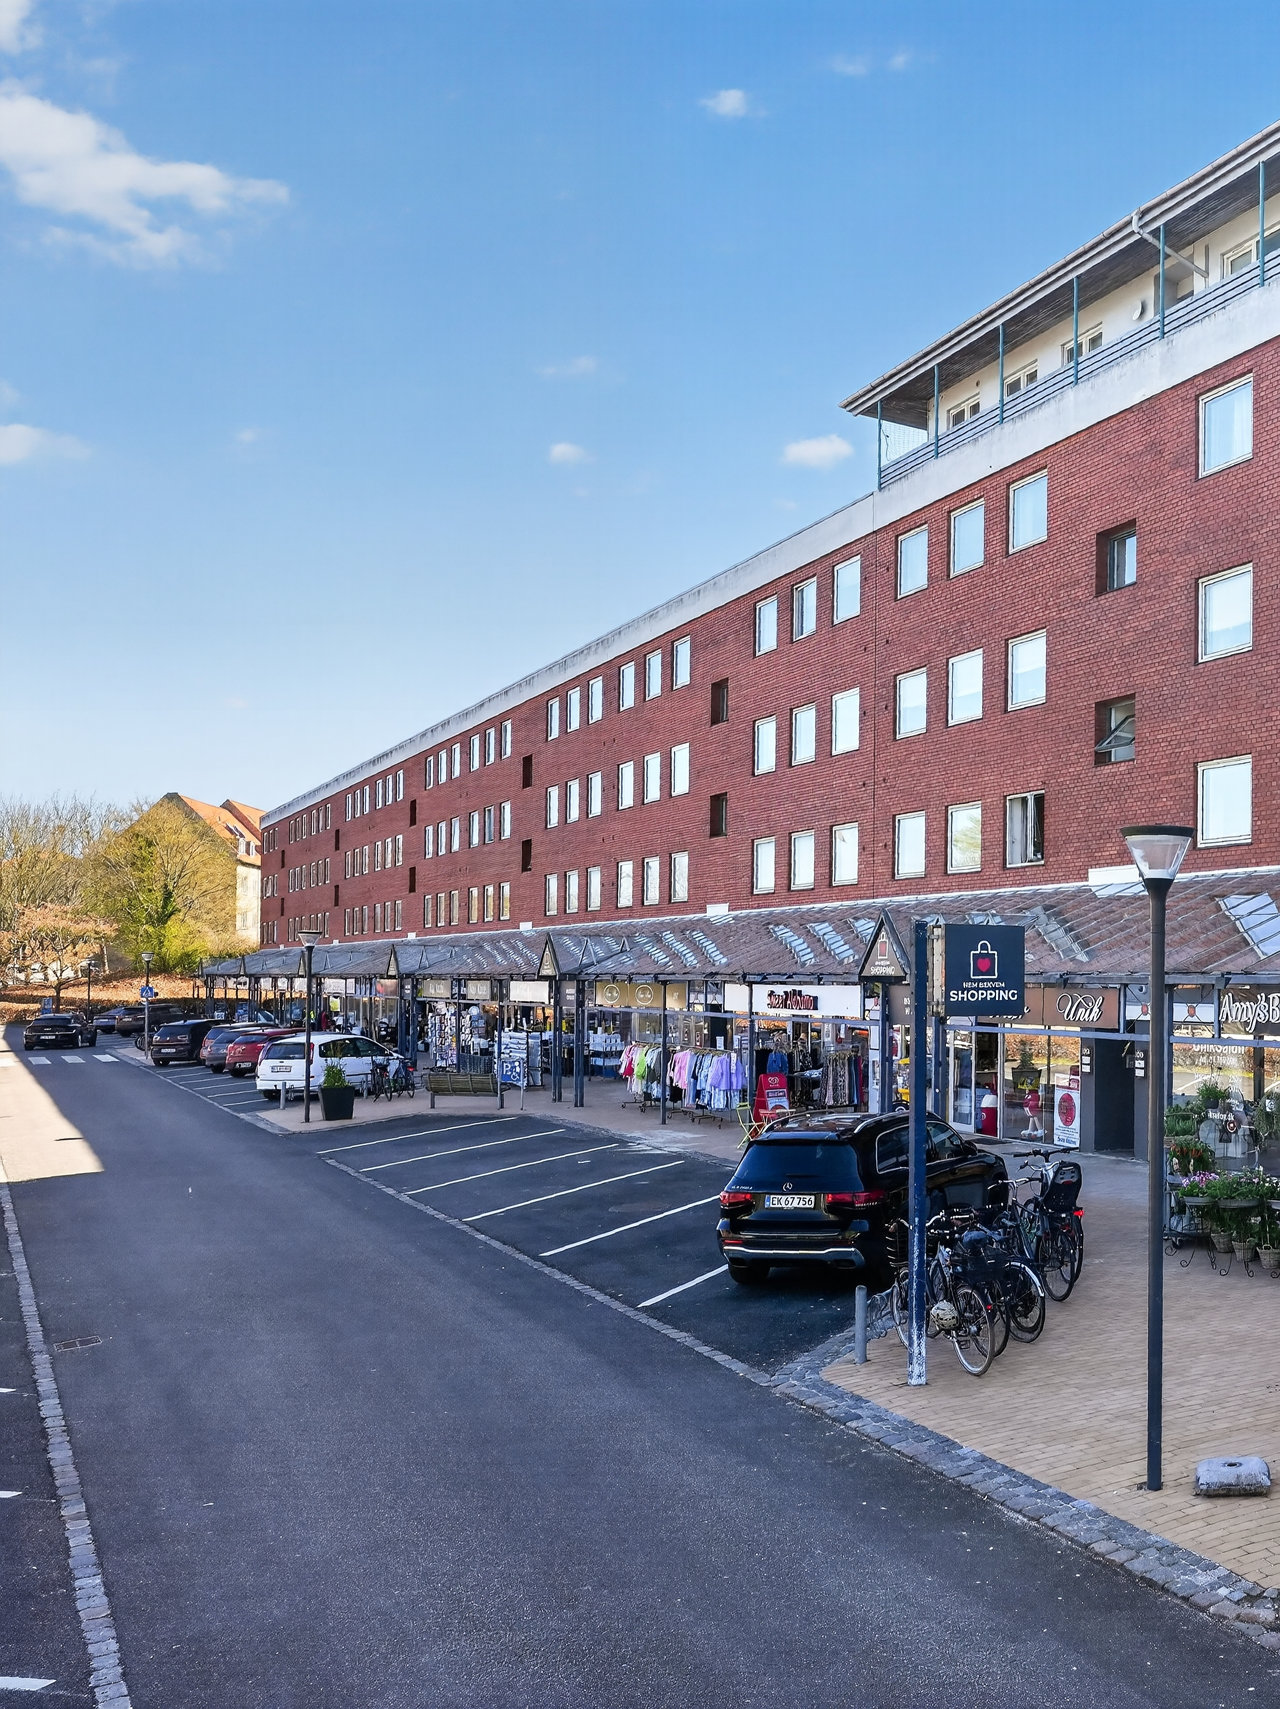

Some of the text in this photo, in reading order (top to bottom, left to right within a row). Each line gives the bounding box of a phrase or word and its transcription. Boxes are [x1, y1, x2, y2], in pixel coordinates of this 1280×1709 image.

[949, 990, 1018, 1001] SHOPPING
[1056, 993, 1104, 1022] Unik
[771, 1196, 813, 1206] EK 67 756
